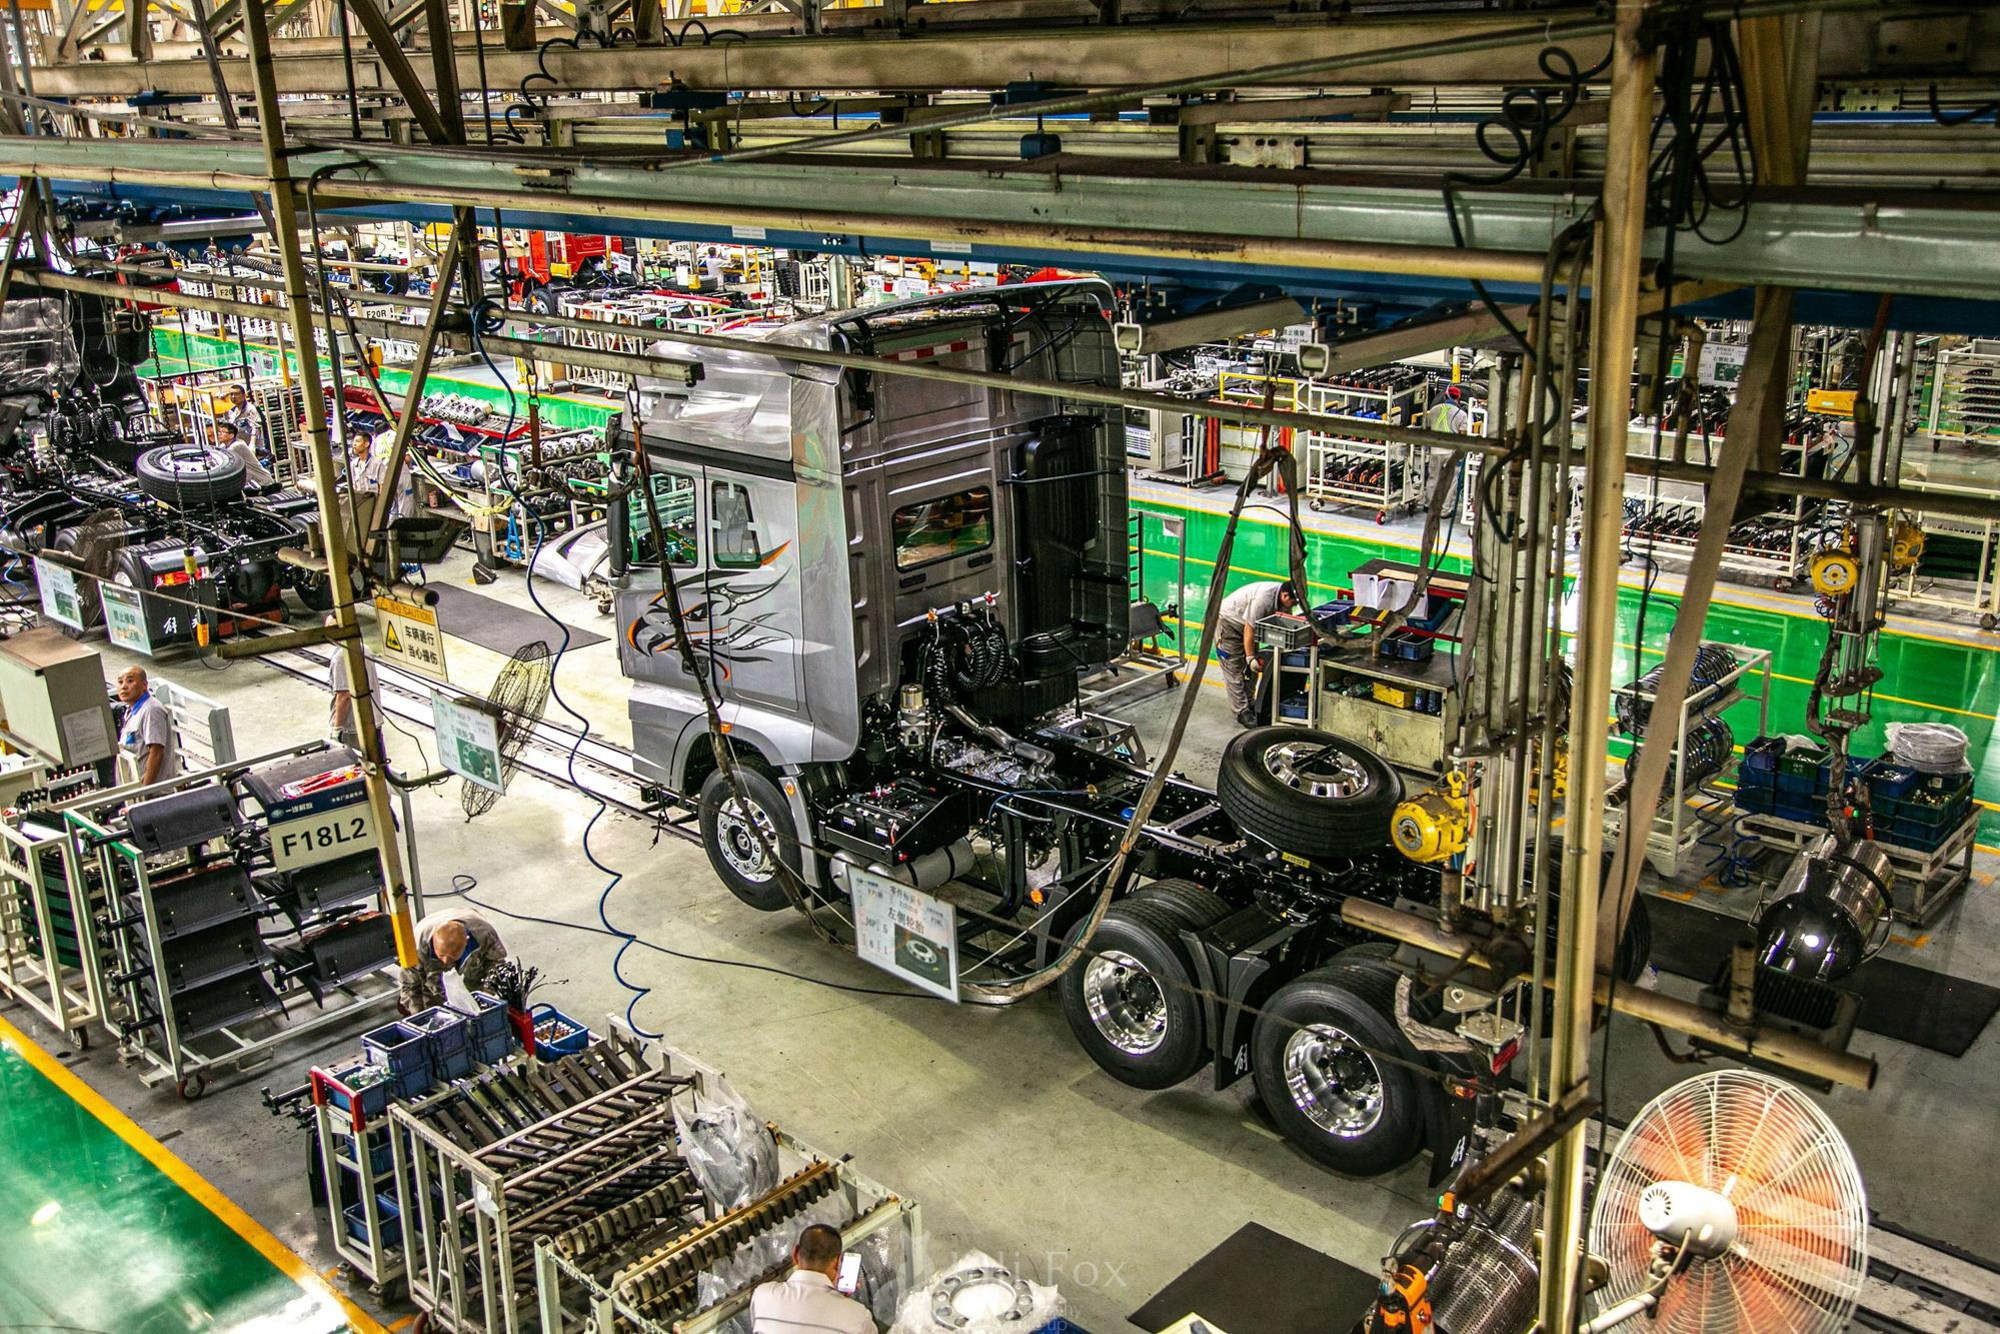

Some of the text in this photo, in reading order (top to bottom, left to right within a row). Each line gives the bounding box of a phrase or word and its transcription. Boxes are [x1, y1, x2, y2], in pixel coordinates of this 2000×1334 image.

[366, 309, 387, 319] F20R
[404, 606, 432, 622] CAUTION
[405, 625, 435, 646] 车辆通行
[408, 645, 438, 665] 当心撞伤
[281, 817, 368, 857] F18L2
[887, 907, 925, 934] 左侧轮胎
